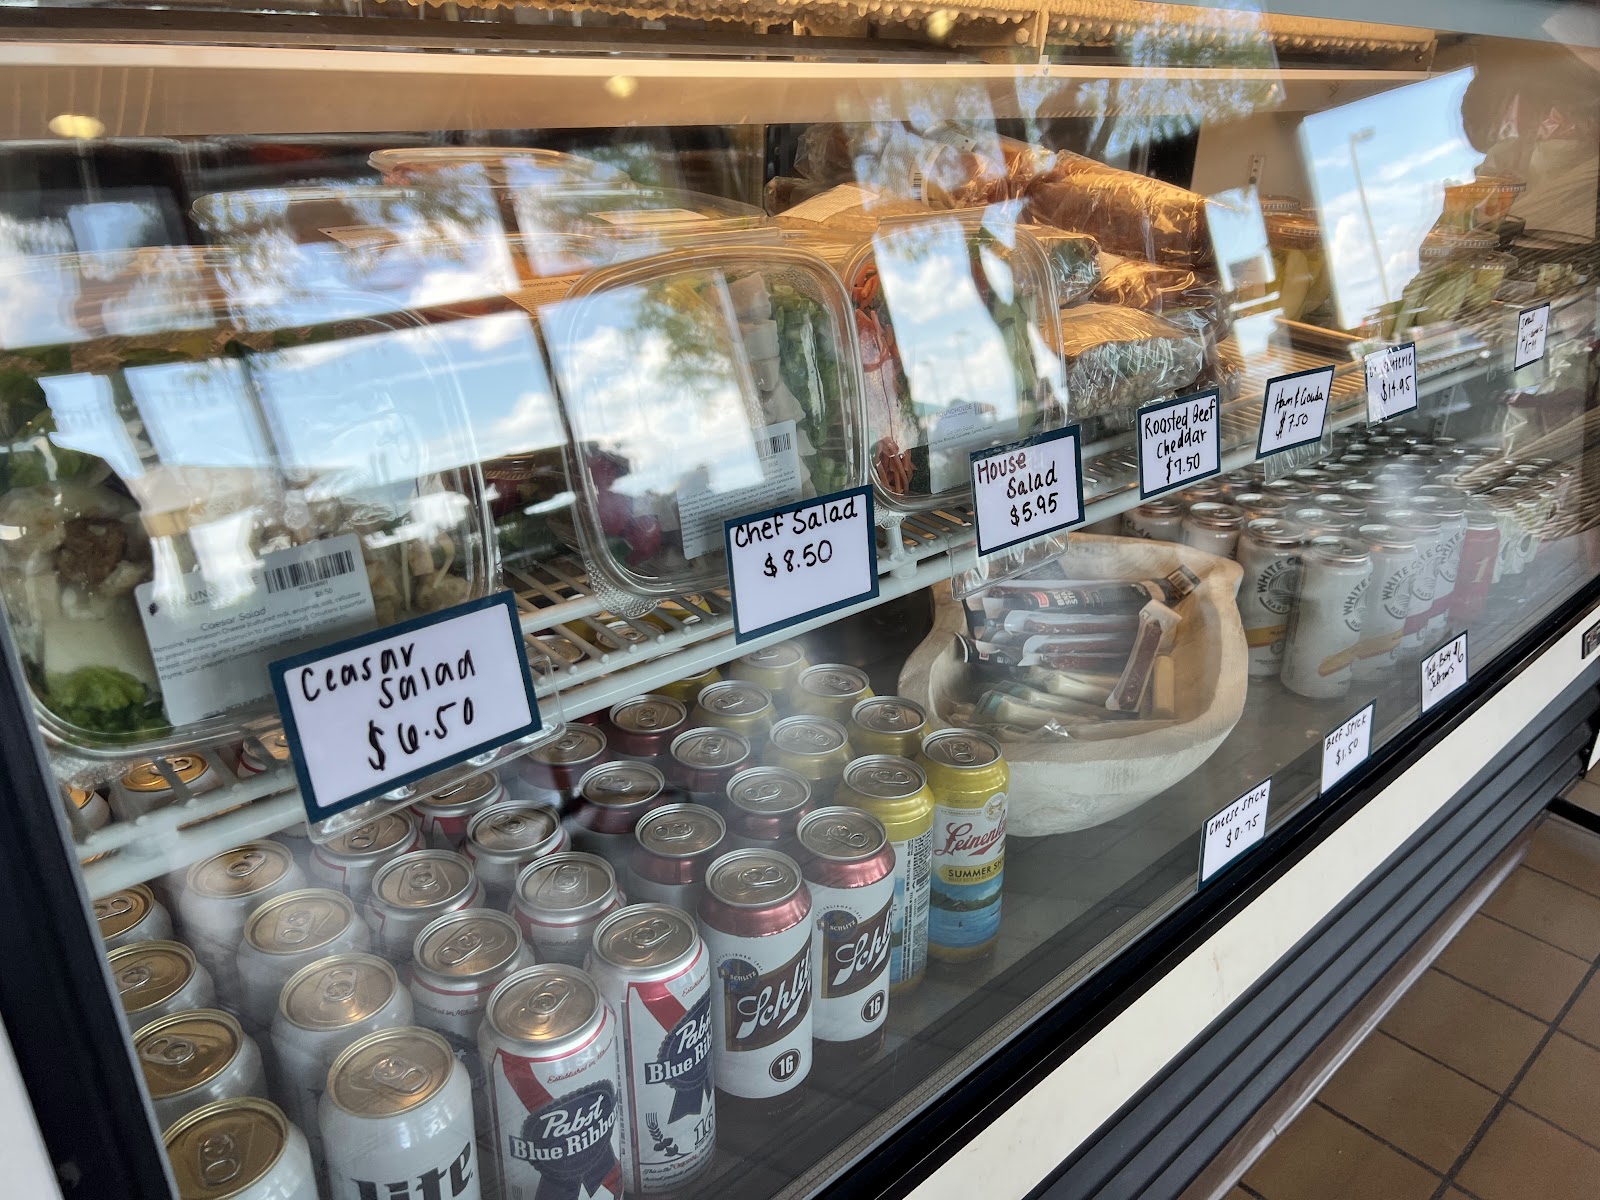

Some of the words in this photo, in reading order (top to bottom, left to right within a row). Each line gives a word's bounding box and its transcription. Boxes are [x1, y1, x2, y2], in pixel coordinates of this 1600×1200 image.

[1274, 387, 1293, 414] Ham
[1300, 386, 1324, 406] Gouda
[1381, 375, 1412, 404] $14.95
[1145, 407, 1188, 440] Roasted
[1192, 398, 1216, 424] Beef
[1275, 411, 1309, 440] $7.50
[1157, 427, 1207, 459] Cheddar
[977, 452, 1026, 485] House
[1007, 460, 1058, 499] Salad
[1166, 453, 1200, 484] $7.50
[735, 512, 784, 548] Chef
[792, 496, 858, 535] Salad
[1010, 492, 1059, 527] $5.95
[763, 539, 833, 578] $8.50
[1257, 561, 1285, 593] WHITE
[1382, 566, 1409, 600] WHITE
[1343, 578, 1366, 616] WHITE
[199, 615, 236, 632] Caesar
[237, 606, 266, 621] Salad
[301, 643, 415, 701] Ceasar
[368, 697, 474, 771] $6.50
[1326, 728, 1343, 751] Beef
[1345, 714, 1366, 737] Stick
[1336, 738, 1358, 766] $1.50
[1209, 806, 1239, 836] Cheese
[1225, 813, 1260, 848] $0.75
[948, 866, 991, 878] SUMMER
[829, 920, 856, 931] SCHLITZ
[729, 970, 757, 982] SCHLITZ
[869, 996, 881, 1018] 16
[547, 1067, 587, 1084] Established
[648, 1057, 692, 1083] Blue
[779, 1055, 794, 1077] 16
[540, 1094, 604, 1139] Pabst
[511, 1137, 563, 1161] Blue
